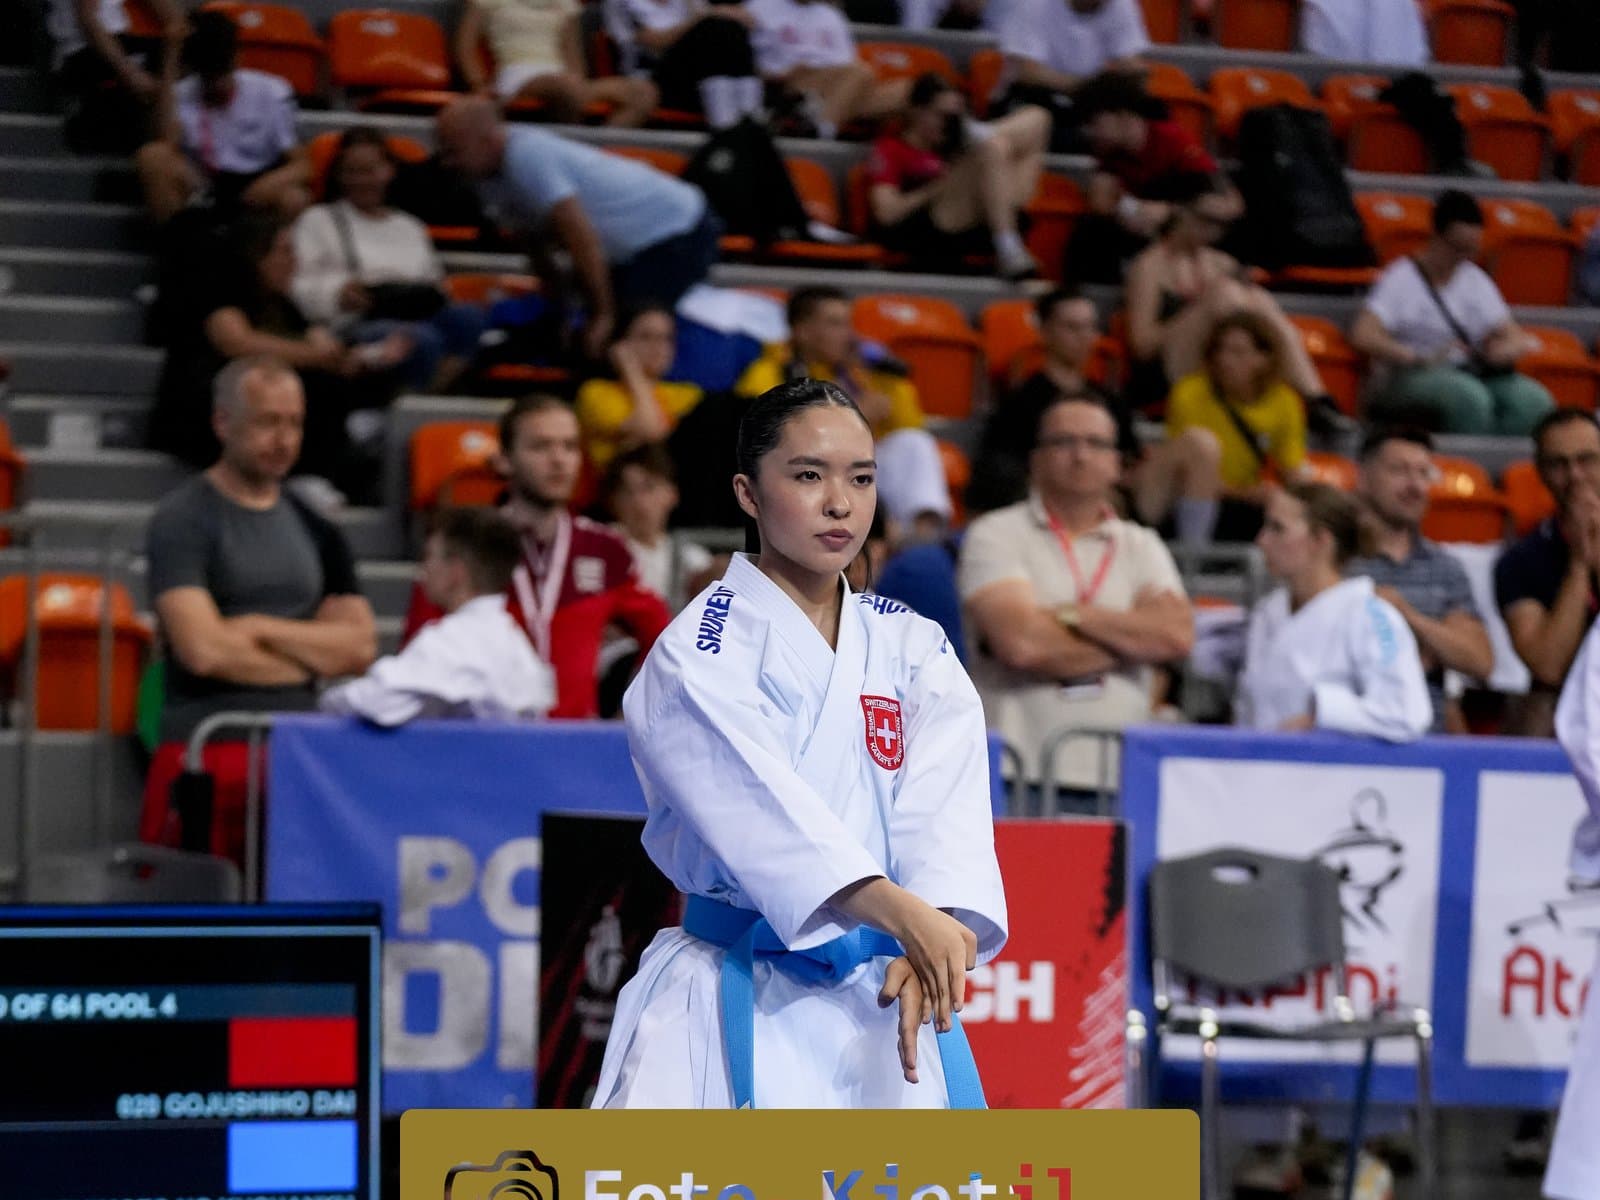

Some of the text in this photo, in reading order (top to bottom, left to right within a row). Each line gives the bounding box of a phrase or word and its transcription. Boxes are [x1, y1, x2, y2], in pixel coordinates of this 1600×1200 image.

[11, 993, 48, 1019] OF
[85, 992, 156, 1018] POOL
[159, 992, 178, 1017] 4
